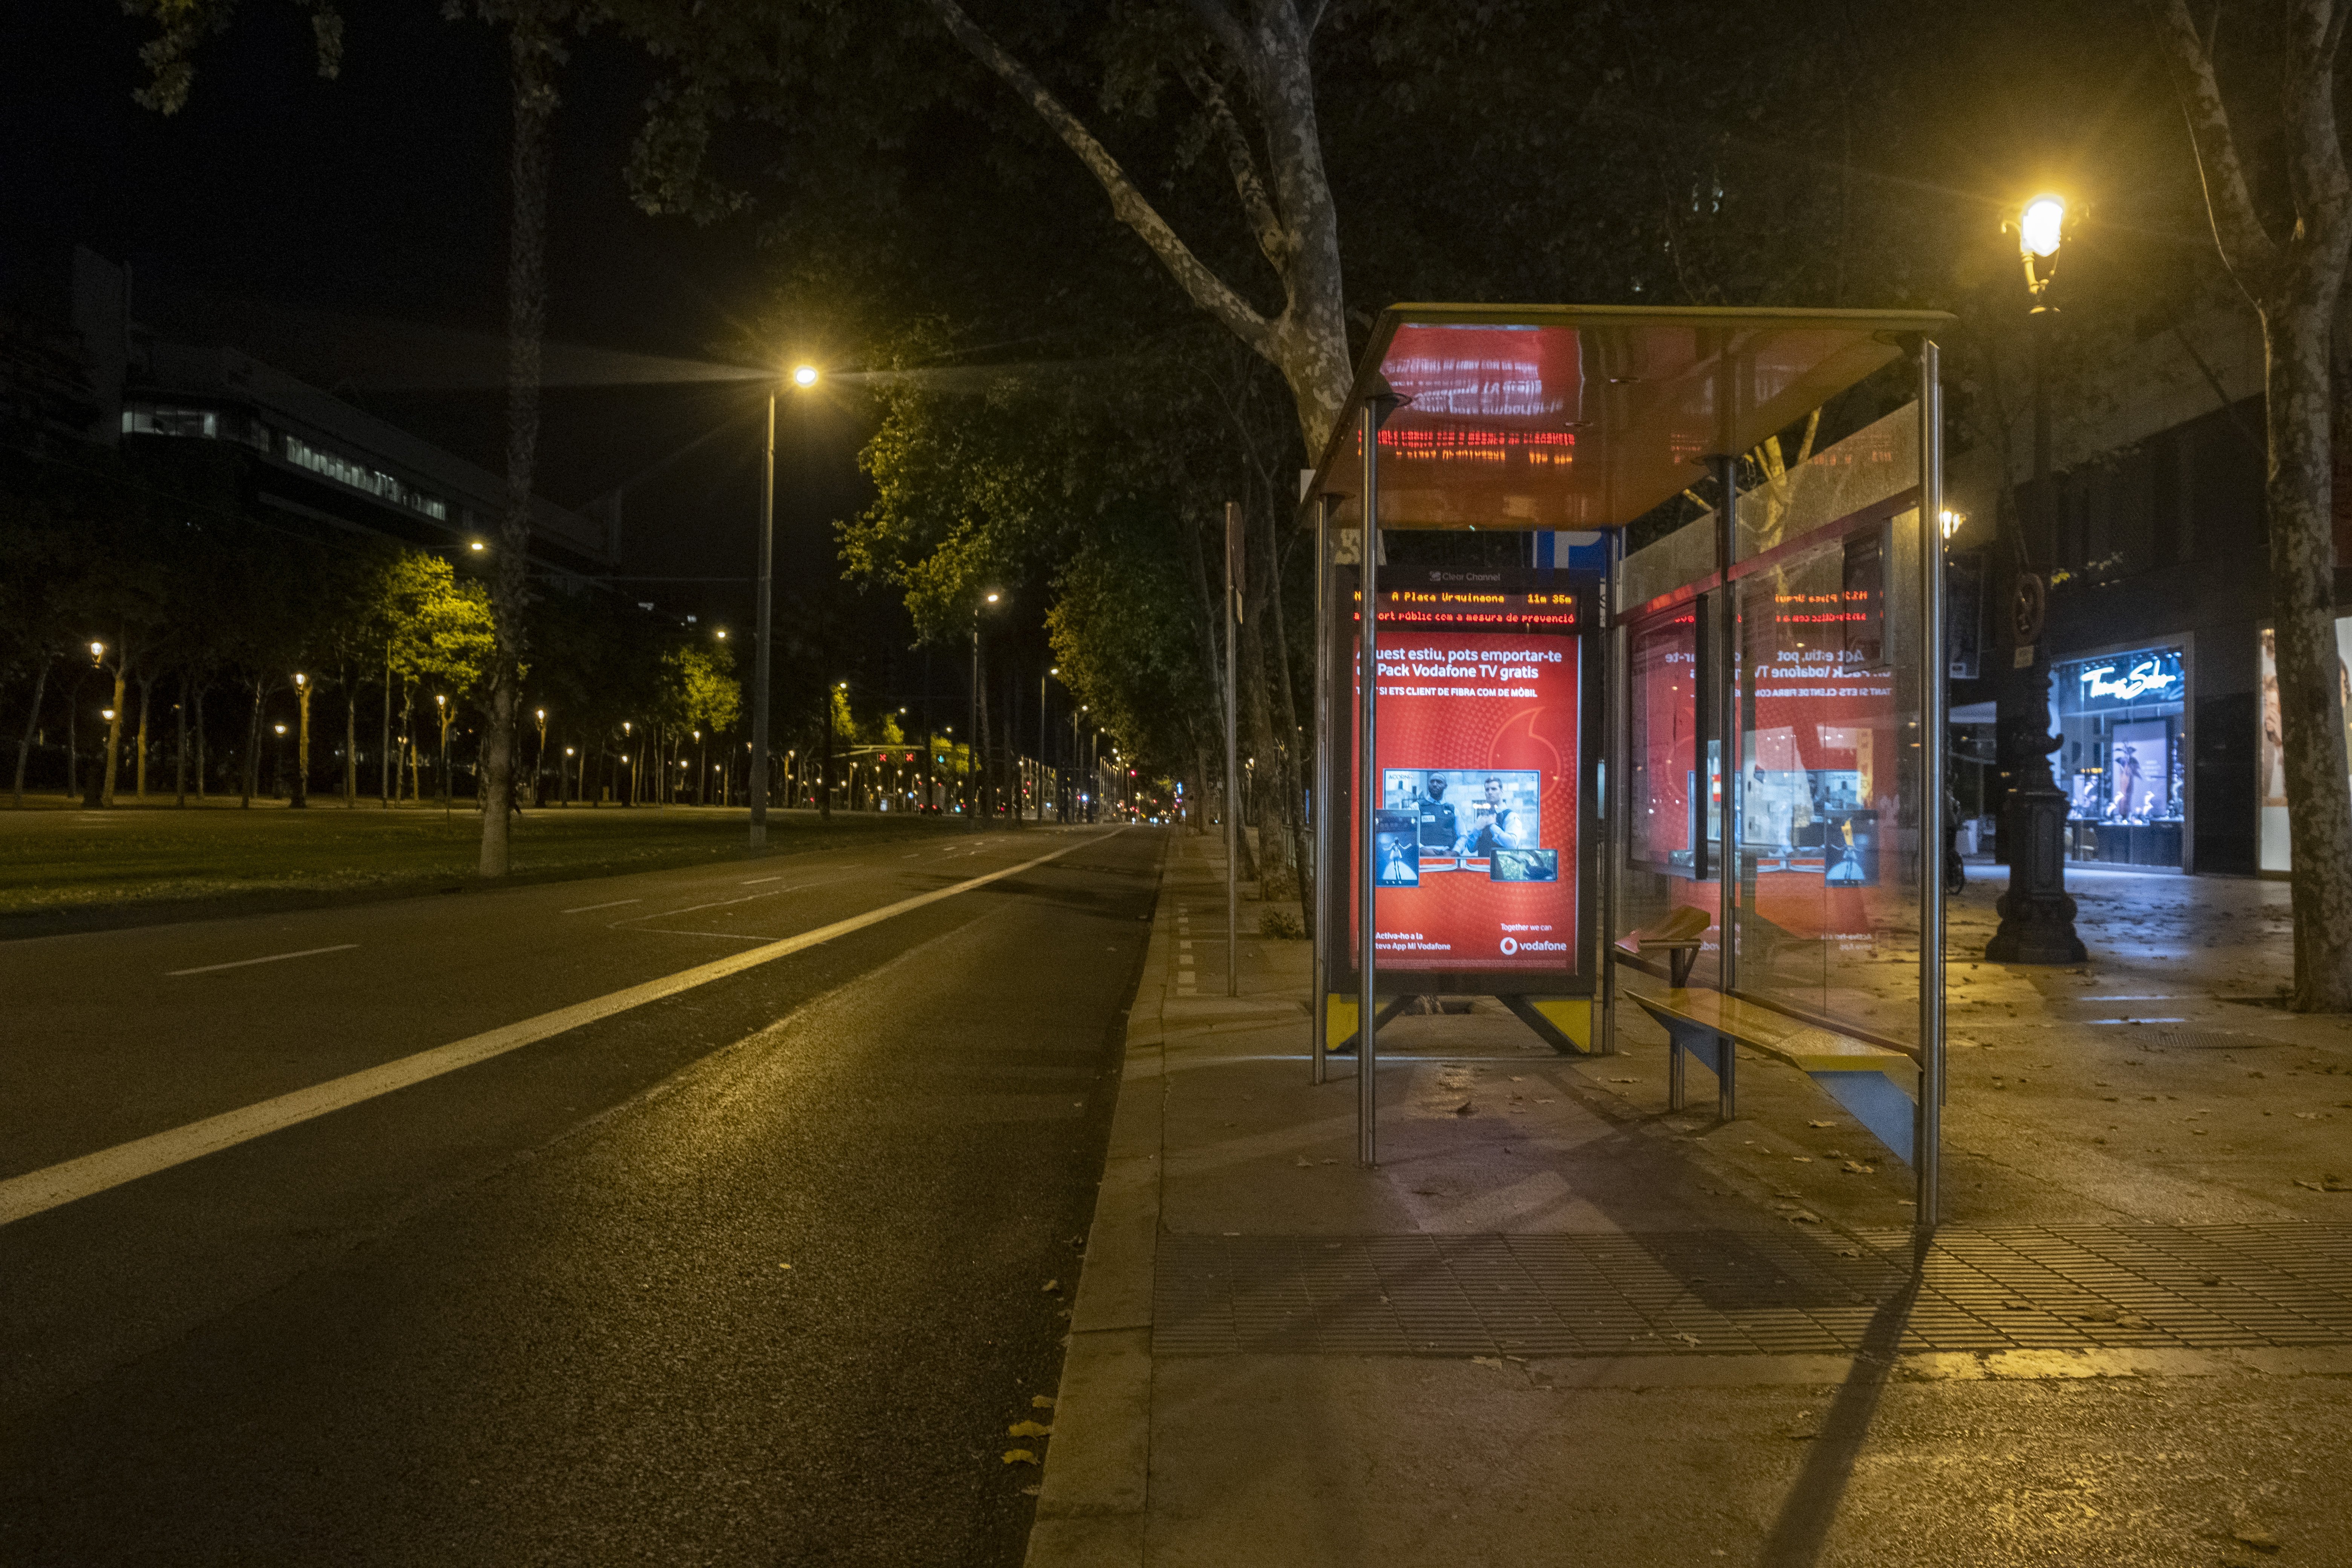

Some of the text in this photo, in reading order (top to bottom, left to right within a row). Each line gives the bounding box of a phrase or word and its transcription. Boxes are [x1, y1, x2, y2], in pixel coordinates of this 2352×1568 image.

[1466, 573, 1501, 581] Channel
[1392, 591, 1399, 601] A
[1408, 647, 1445, 662] estiu,
[1448, 649, 1478, 663] pots
[1481, 650, 1562, 664] emportar-te
[1378, 663, 1539, 681] Pack Vodafone TV gratis
[1380, 687, 1387, 695] SI
[1389, 687, 1404, 695] ETS
[1406, 687, 1436, 695] CLIENT
[1438, 688, 1449, 696] DE
[1452, 688, 1476, 696] FIBRA
[1477, 688, 1496, 697] COM
[1498, 688, 1509, 697] DE
[1501, 923, 1528, 932] Together
[1519, 940, 1567, 951] vodafone
